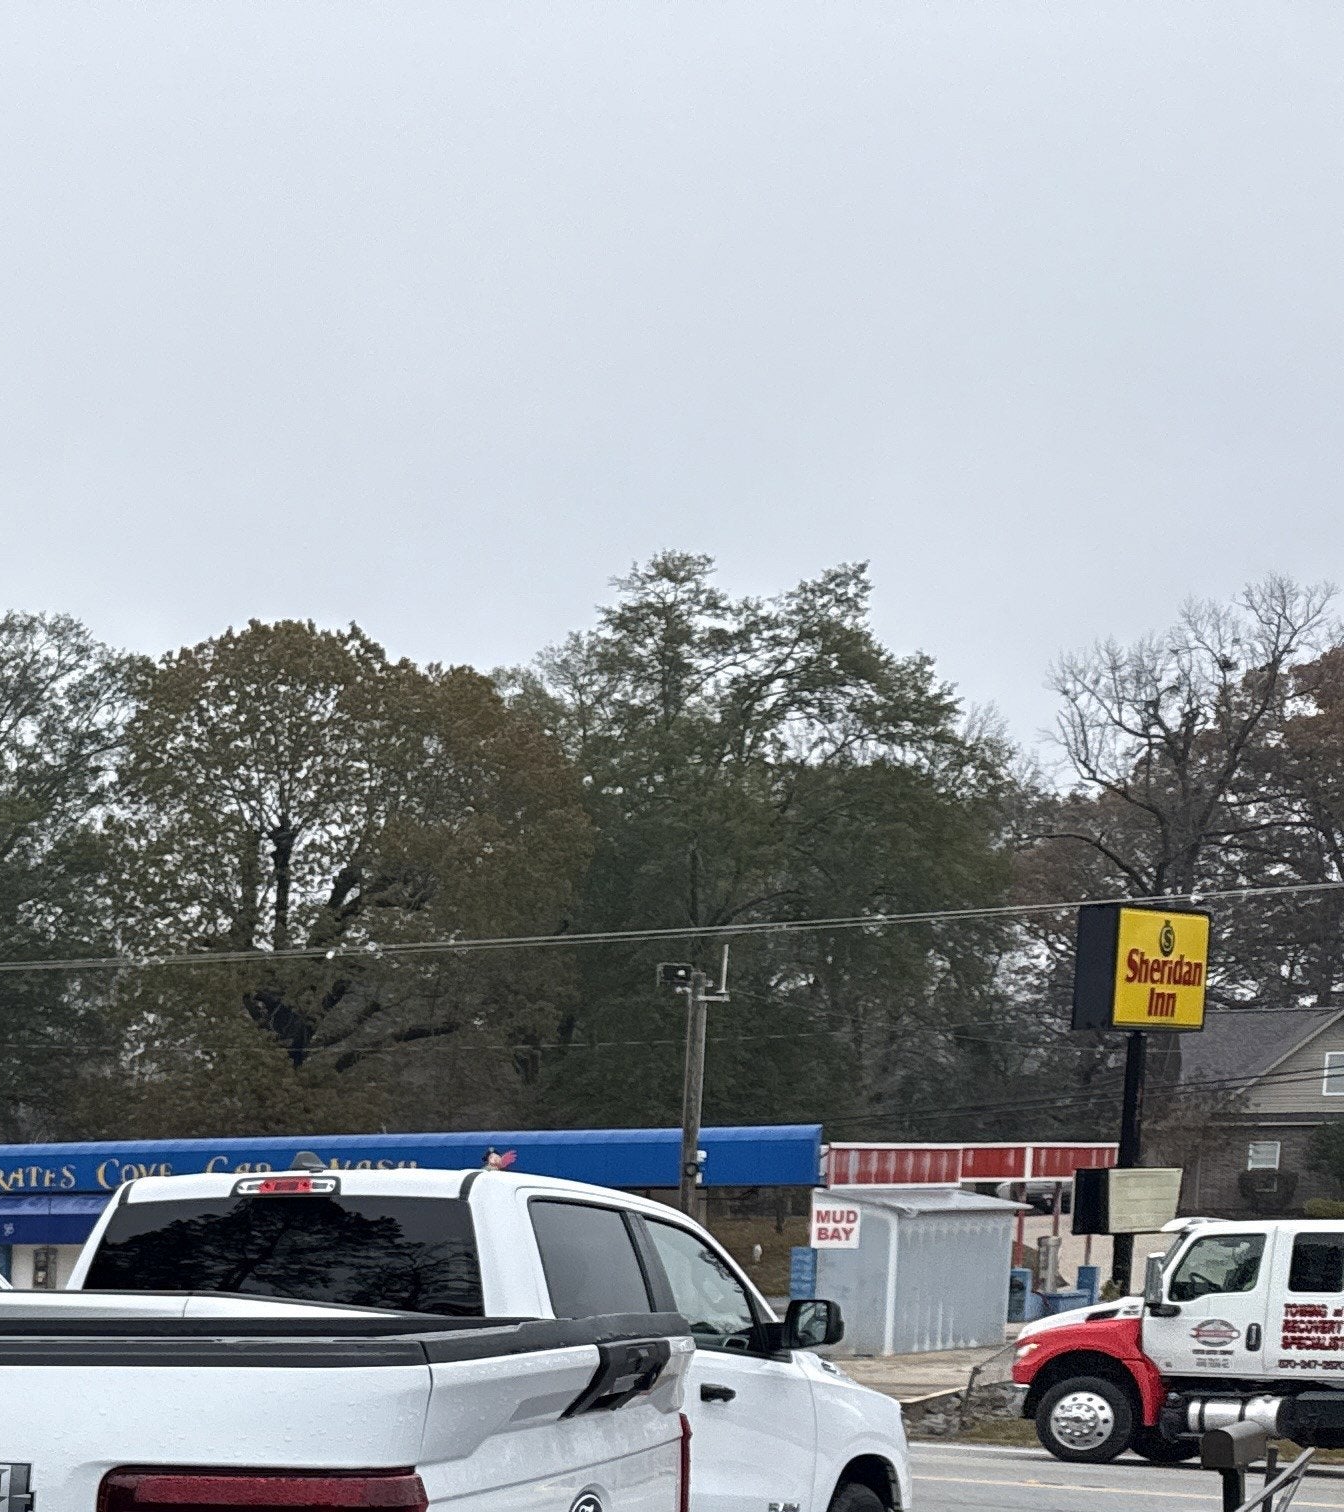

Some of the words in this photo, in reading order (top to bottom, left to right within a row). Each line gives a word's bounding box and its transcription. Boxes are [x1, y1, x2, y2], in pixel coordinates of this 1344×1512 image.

[1125, 948, 1203, 987] Sheridan
[1147, 987, 1177, 1018] Inn
[816, 1210, 858, 1224] MUD
[817, 1227, 855, 1241] BAY
